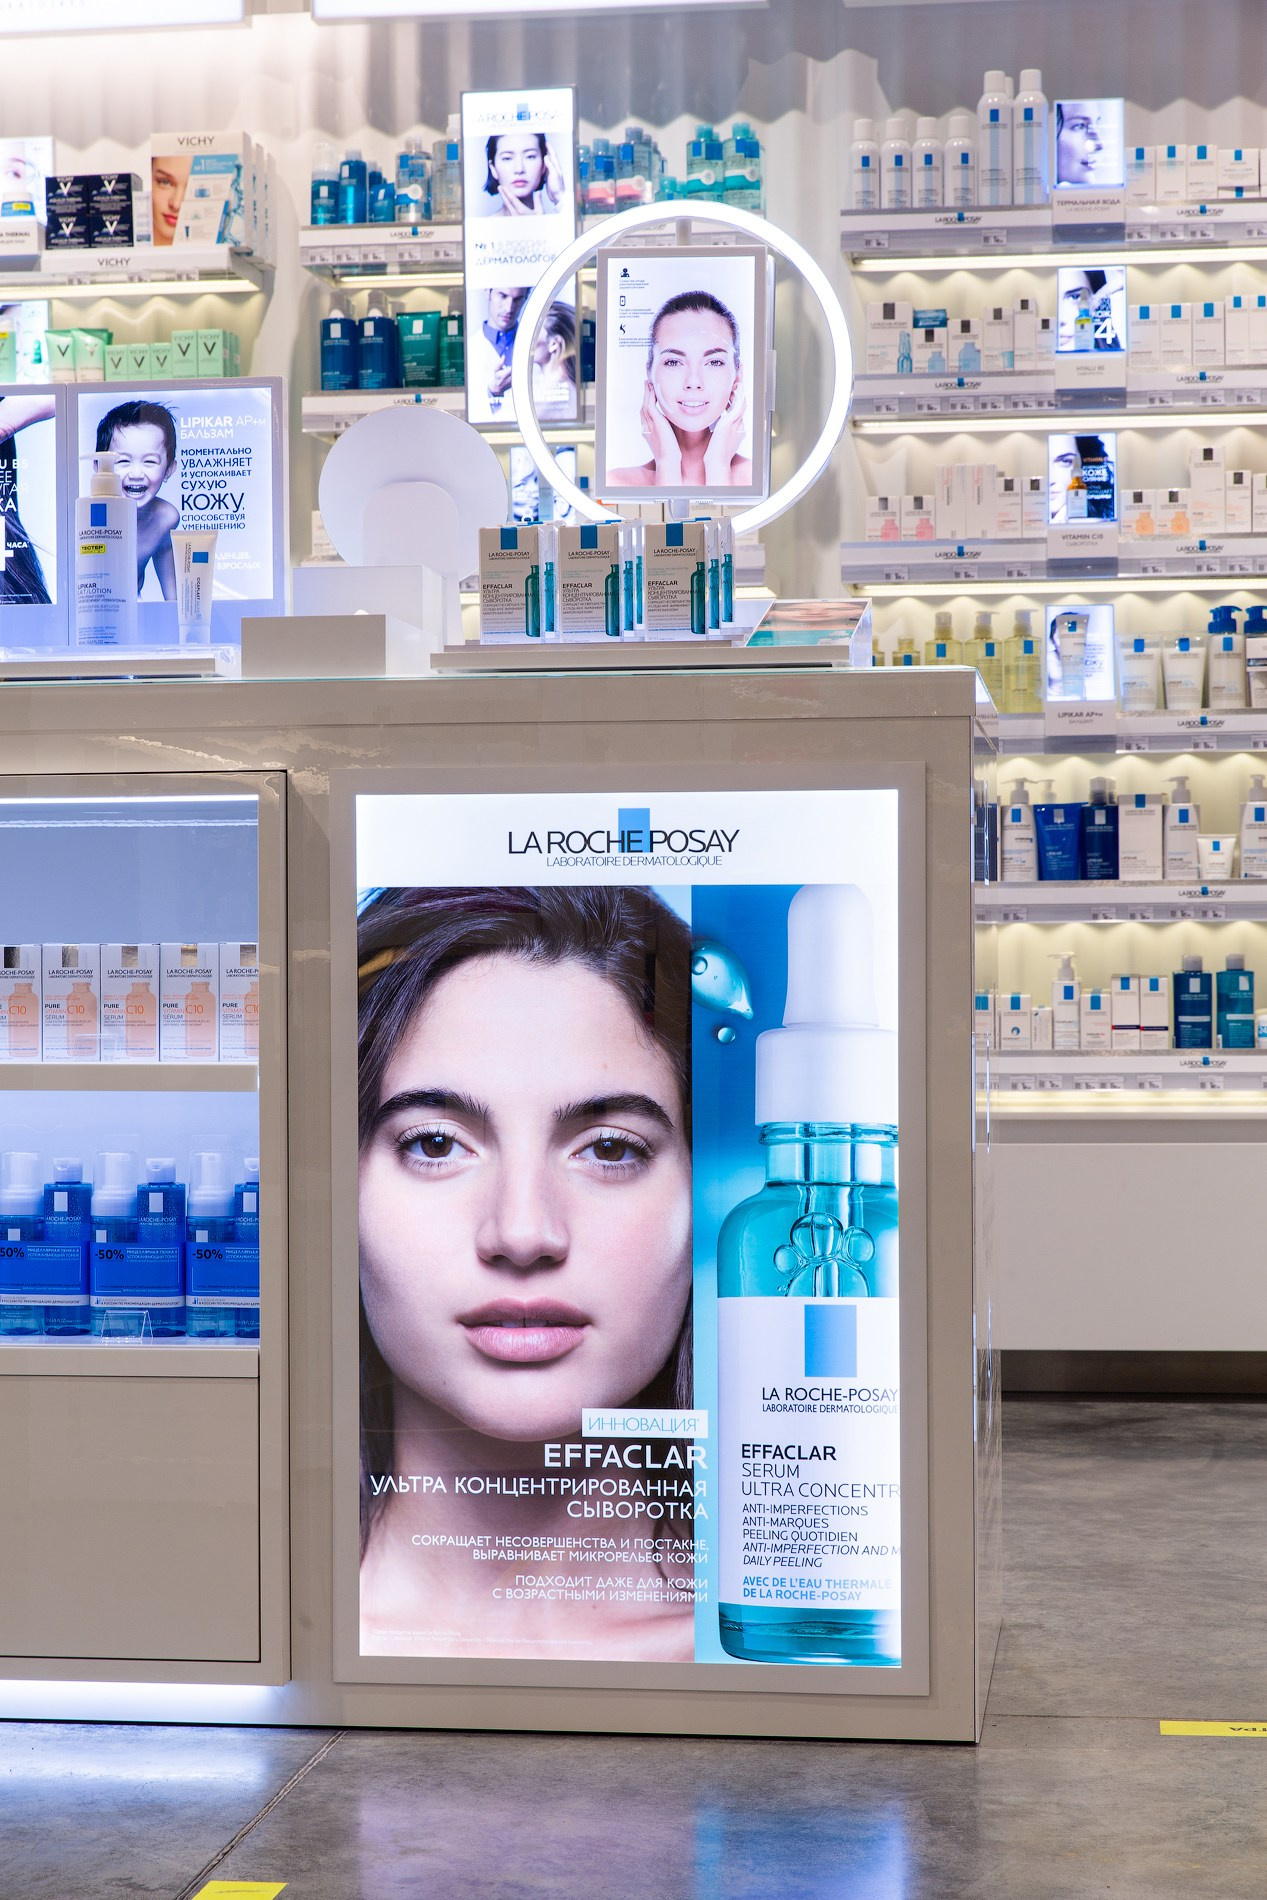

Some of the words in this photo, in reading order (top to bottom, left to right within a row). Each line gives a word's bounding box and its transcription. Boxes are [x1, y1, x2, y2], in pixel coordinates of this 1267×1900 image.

[178, 136, 215, 146] VICHY
[98, 258, 131, 267] VICHY
[180, 416, 233, 428] LIPIKAR
[180, 428, 234, 440] БАЛЬЗАМ
[181, 447, 252, 456] МОМЕНТАЛЬНО
[181, 457, 253, 470] УВЛАЖНЯЕТ
[189, 470, 253, 479] УСПОКАИВАЕТ
[181, 480, 227, 491] СУХУЮ
[181, 493, 245, 513] КОЖУ,
[181, 513, 246, 522] СПОСОБСТВУЯ
[182, 522, 246, 531] УМЕНЬШЕНИЮ
[508, 831, 543, 855] LA
[547, 830, 643, 854] ROCHE
[649, 829, 741, 854] POSAY
[546, 855, 622, 867] LABORATOIRE
[622, 855, 723, 868] DERMATOLOGIQUE
[9, 1005, 27, 1015] C10
[67, 1005, 85, 1015] C10
[126, 1005, 144, 1015] C10
[186, 1005, 204, 1014] C10
[95, 1249, 124, 1259] -50%
[192, 1249, 223, 1260] -50%
[762, 1387, 780, 1401] LA
[785, 1387, 899, 1402] ROCHE-POSAY
[762, 1404, 817, 1413] LABORATOIRE
[819, 1404, 899, 1414] DERMATOLOGIQUE
[544, 1443, 709, 1470] EFFACLAR
[741, 1443, 837, 1461] EFFACLAR
[741, 1463, 800, 1479] SERUM
[370, 1475, 447, 1496] УЛЬТРА
[455, 1476, 708, 1498] КОНЦЕНТРИРОВАННАЯ
[741, 1481, 795, 1497] ULTRA
[798, 1482, 900, 1499] CONCENTR
[566, 1501, 709, 1520] СЫВОРОТКА
[742, 1504, 868, 1516] ANTI-IMPERFECTIONS
[742, 1517, 829, 1530] ANTI-MARQUES
[743, 1529, 789, 1541] PEELING
[791, 1530, 858, 1543] QUOTIDIEN
[411, 1534, 492, 1549] СОКРАЩАЕТ
[495, 1535, 617, 1550] НЕСОВЕРШЕНСТВА
[620, 1538, 630, 1549] И
[634, 1538, 710, 1552] ПОСТАКНЕ,
[742, 1542, 859, 1556] ANTI-IMPERFECTION
[862, 1545, 889, 1556] AND
[472, 1549, 565, 1562] ВЫРАВНИВАЕТ
[569, 1550, 663, 1564] МИКРОРЕЛЬЕФ
[667, 1553, 709, 1564] КОЖИ
[743, 1555, 772, 1567] DAILY
[773, 1556, 823, 1568] PEELING
[515, 1575, 592, 1590] ПОДХОДИТ
[595, 1576, 633, 1590] ДАЖЕ
[637, 1577, 664, 1590] ДЛЯ
[667, 1578, 709, 1590] КОЖИ
[742, 1576, 769, 1588] AVEC
[772, 1577, 786, 1588] DE
[789, 1577, 822, 1589] L'EAU
[825, 1578, 891, 1590] THERMALE
[492, 1588, 502, 1599] С
[505, 1588, 606, 1601] ВОЗРАСТНЫМИ
[609, 1590, 709, 1603] ИЗМЕНЕНИЯМИ
[743, 1588, 757, 1598] DE
[759, 1589, 773, 1599] LA
[775, 1589, 862, 1601] ROCHE-POSAY
